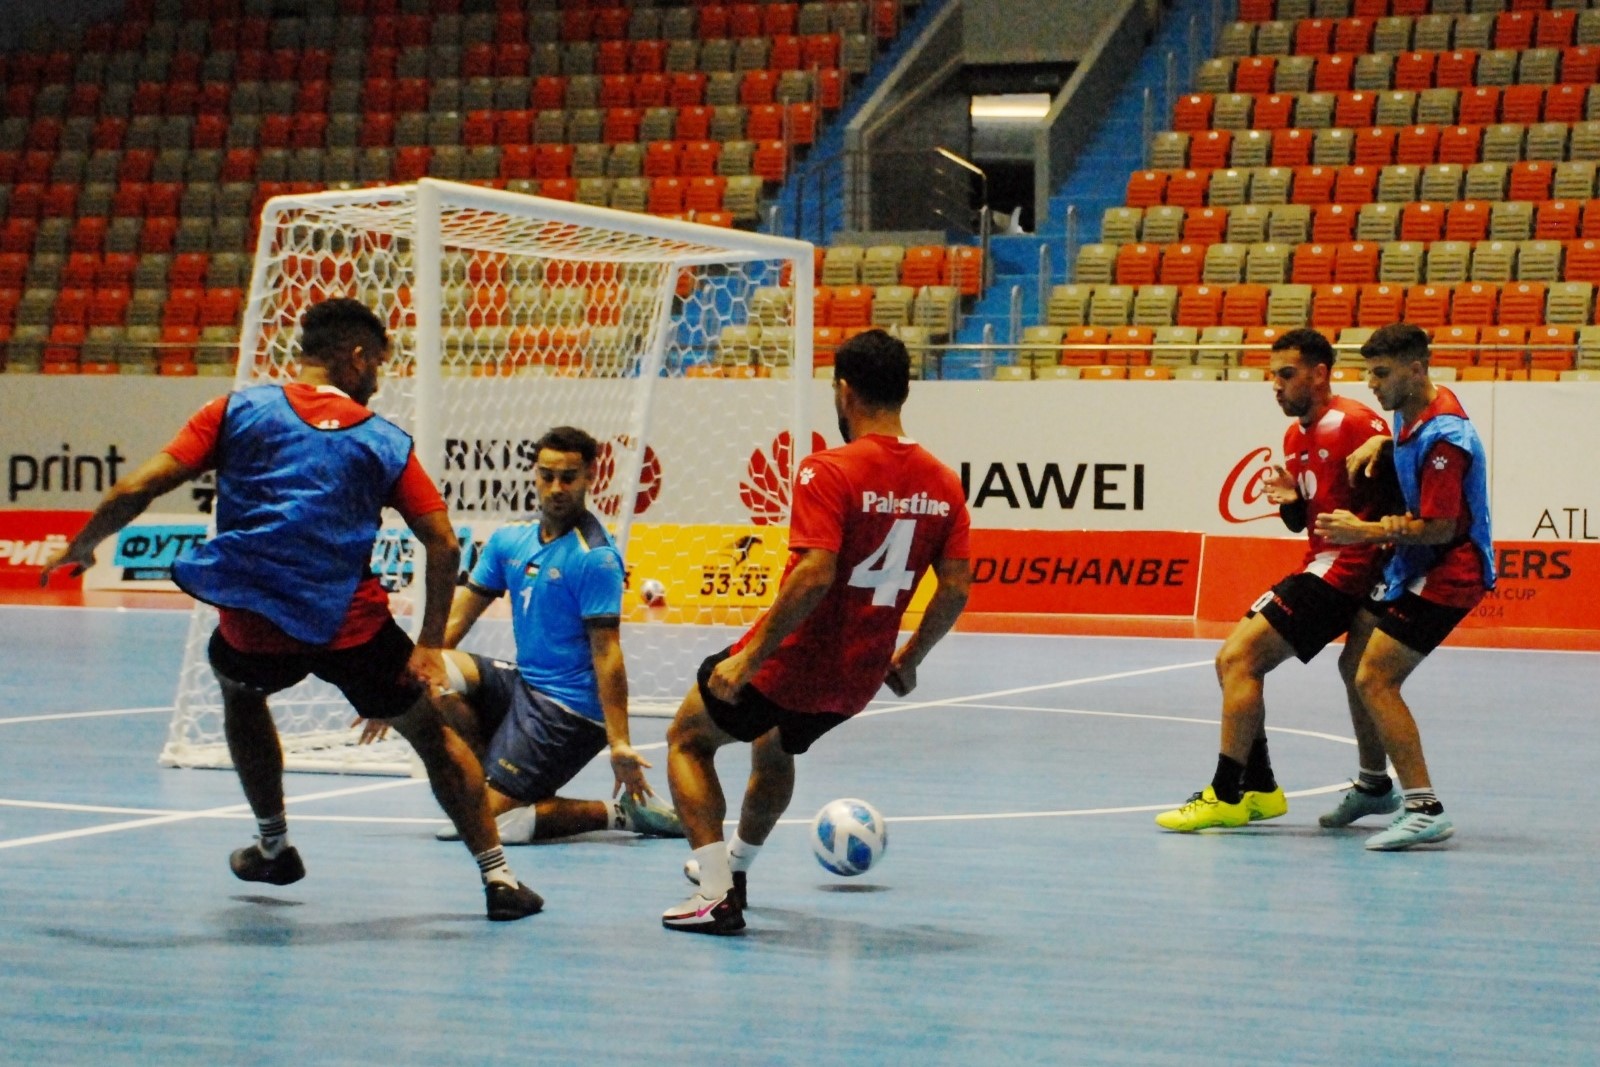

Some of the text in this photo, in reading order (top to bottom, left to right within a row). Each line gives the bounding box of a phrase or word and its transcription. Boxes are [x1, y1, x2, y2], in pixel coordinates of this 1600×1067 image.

[10, 443, 125, 501] print
[862, 490, 950, 517] Palestine
[1532, 508, 1599, 539] ATL
[847, 518, 917, 607] 4
[972, 556, 1189, 586] DUSHANBE
[1494, 549, 1572, 579] ERS
[519, 586, 533, 615] 1
